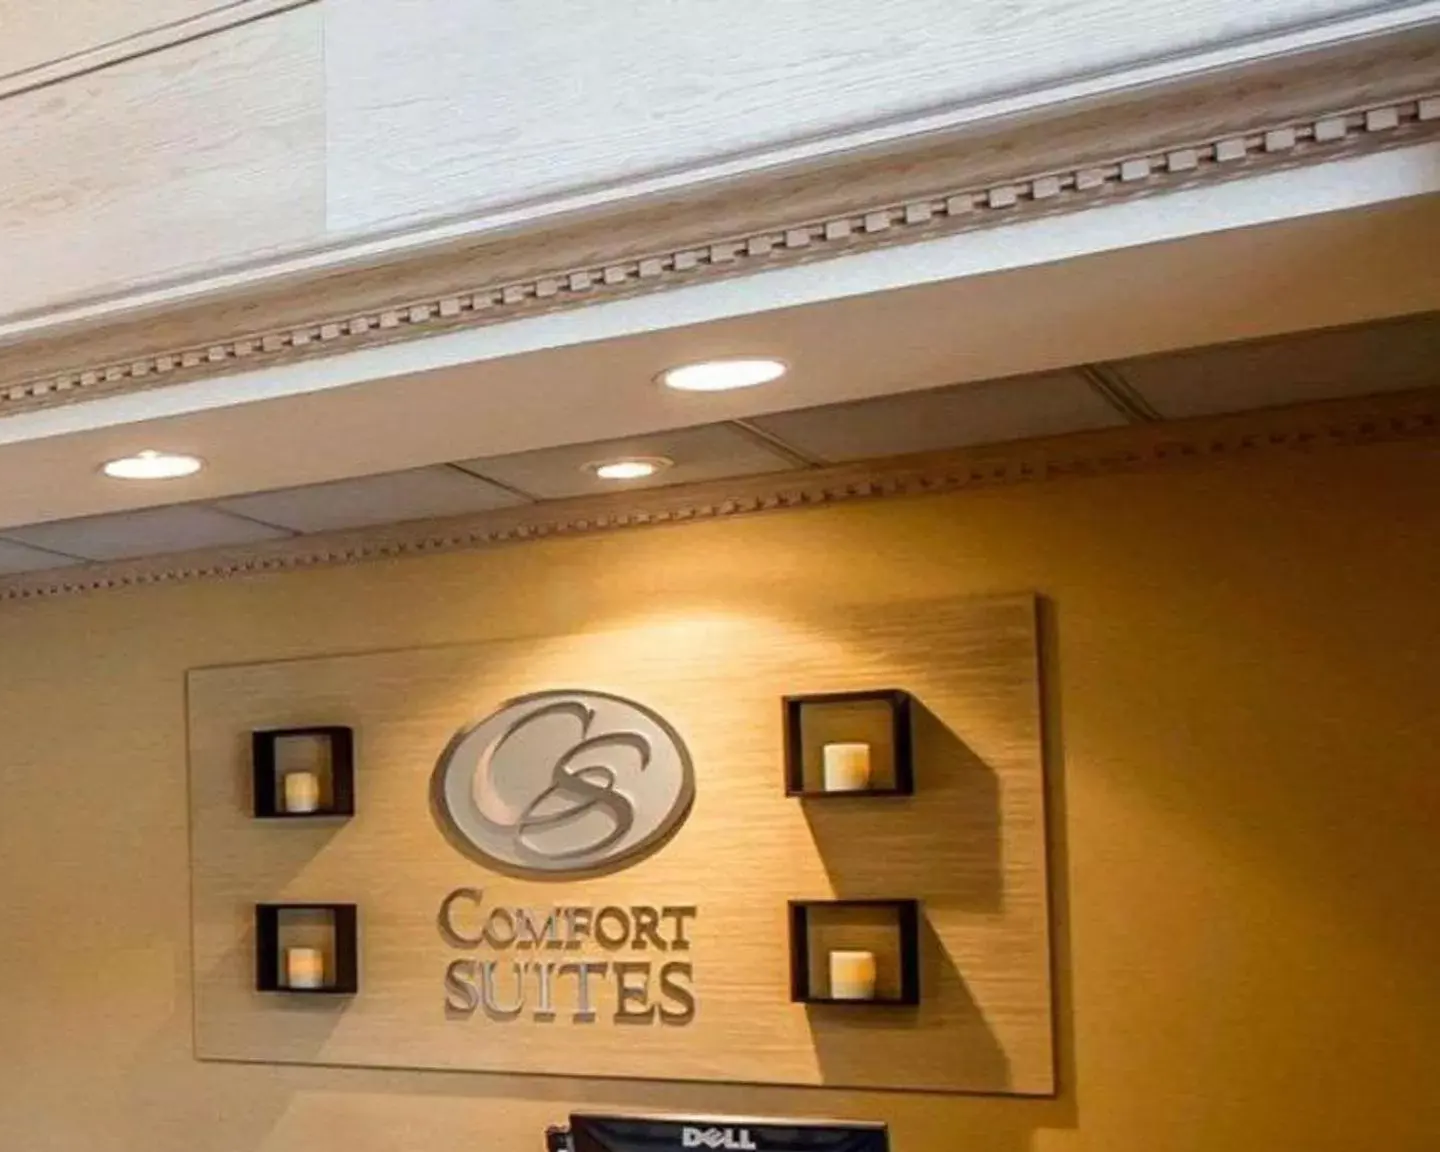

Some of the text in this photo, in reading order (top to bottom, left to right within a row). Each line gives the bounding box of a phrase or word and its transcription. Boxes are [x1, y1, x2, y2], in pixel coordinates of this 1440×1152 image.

[437, 888, 697, 951] COMFORT
[444, 958, 697, 1026] SUITES
[682, 1127, 757, 1150] DELL
